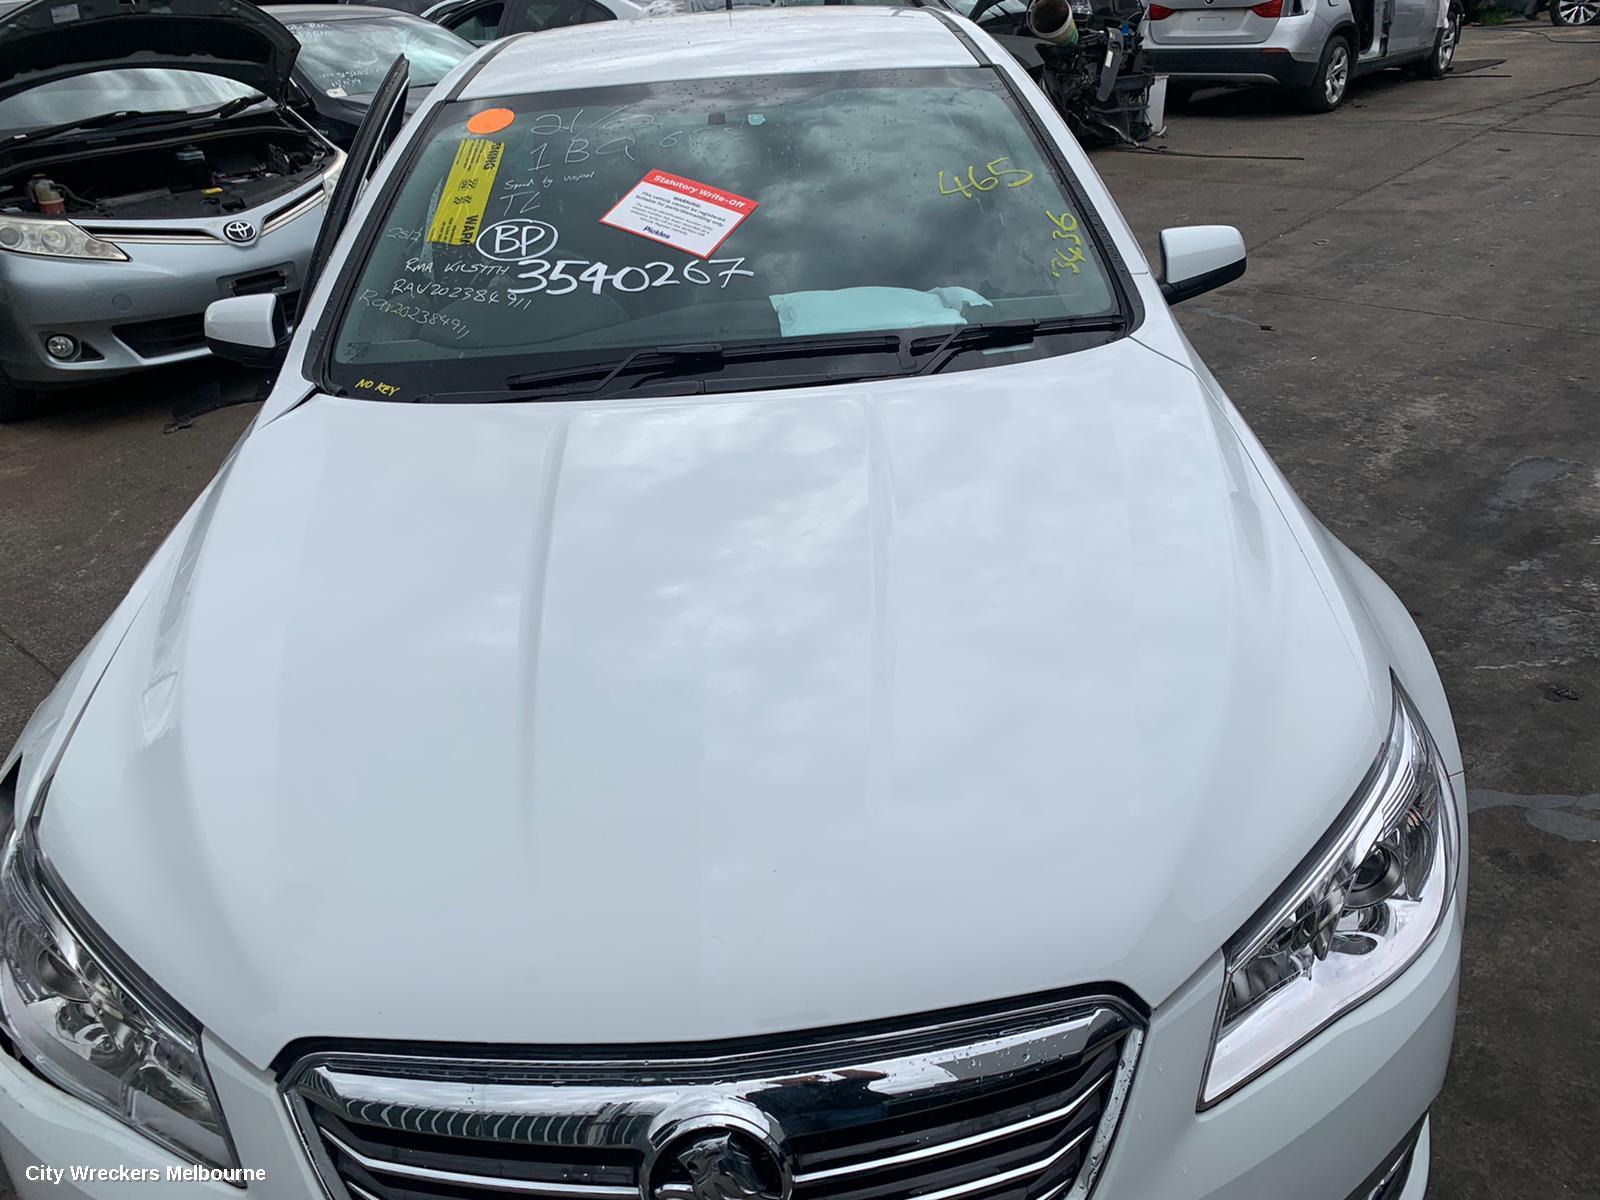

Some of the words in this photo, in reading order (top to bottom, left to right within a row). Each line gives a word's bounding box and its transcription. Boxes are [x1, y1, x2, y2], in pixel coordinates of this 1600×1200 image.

[653, 175, 698, 193] Statutory
[699, 189, 747, 209] Write-Off
[938, 157, 1035, 199] 465
[494, 225, 545, 256] BP
[642, 226, 671, 240] Pickles
[507, 257, 754, 295] 3540267
[355, 379, 374, 388] NO
[375, 382, 400, 396] KEY
